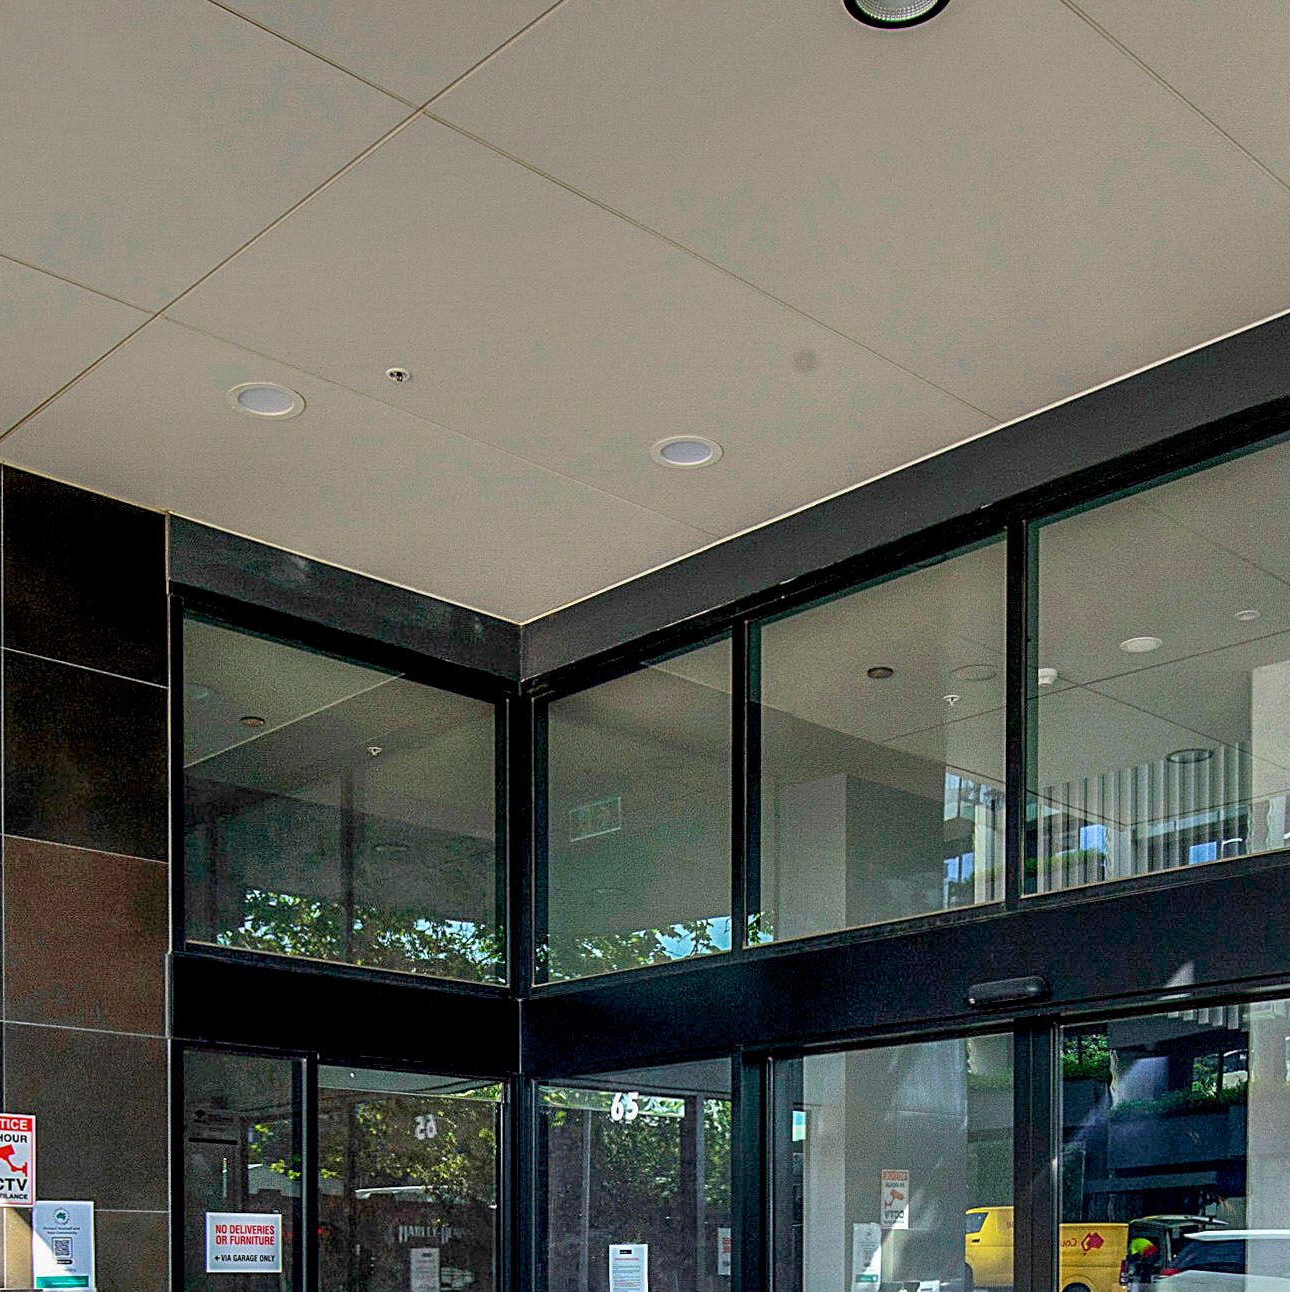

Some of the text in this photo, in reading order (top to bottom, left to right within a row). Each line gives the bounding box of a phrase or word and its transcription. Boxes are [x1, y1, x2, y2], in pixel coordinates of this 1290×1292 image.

[610, 1092, 639, 1121] 65
[215, 1225, 275, 1235] NO DELIVERIES
[215, 1236, 275, 1246] OR FURNITURE
